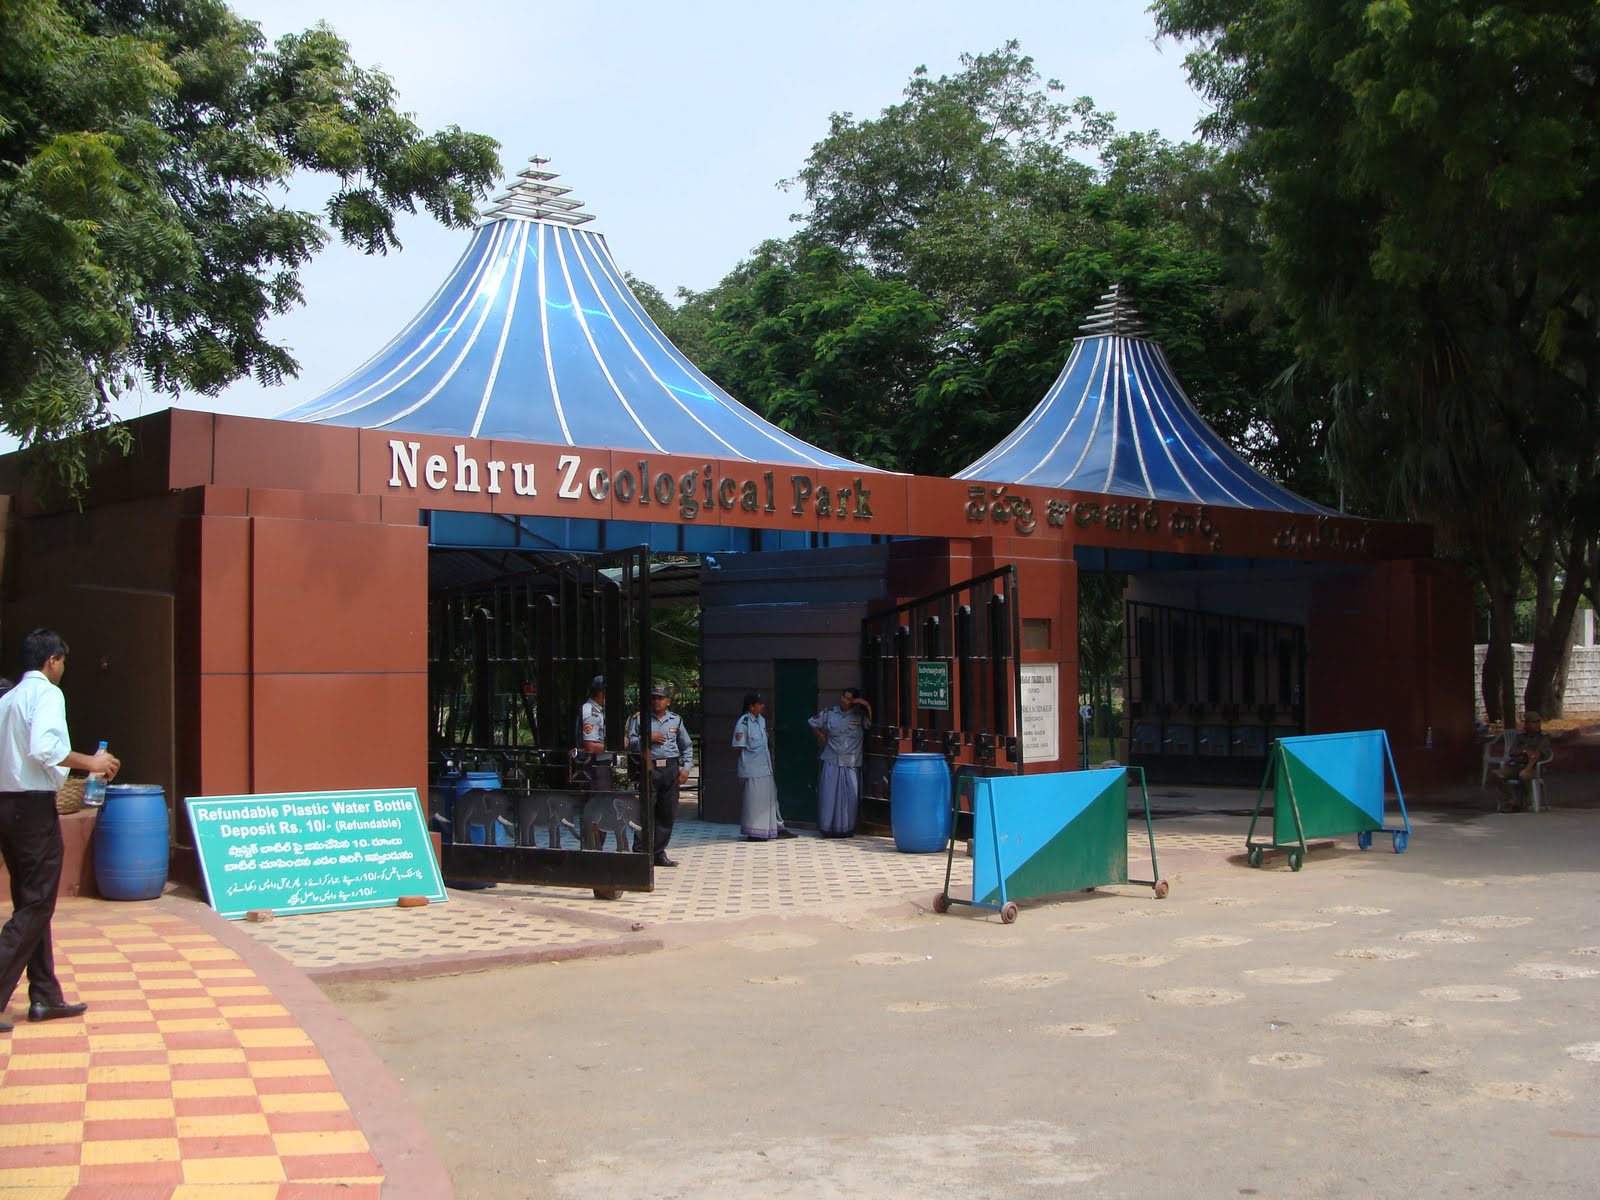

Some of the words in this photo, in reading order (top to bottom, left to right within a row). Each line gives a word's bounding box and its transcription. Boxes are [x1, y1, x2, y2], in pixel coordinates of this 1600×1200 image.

[388, 439, 538, 497] Nehru
[558, 454, 777, 519] Zoological
[791, 473, 875, 519] Park
[197, 805, 279, 821] Refundable
[282, 802, 330, 817] Plastic
[332, 801, 370, 814] Water
[374, 799, 412, 812] Bottle
[220, 822, 277, 839] Deposit
[279, 822, 302, 834] Rs.
[306, 819, 331, 832] 10/-
[336, 818, 402, 833] (Refundable)
